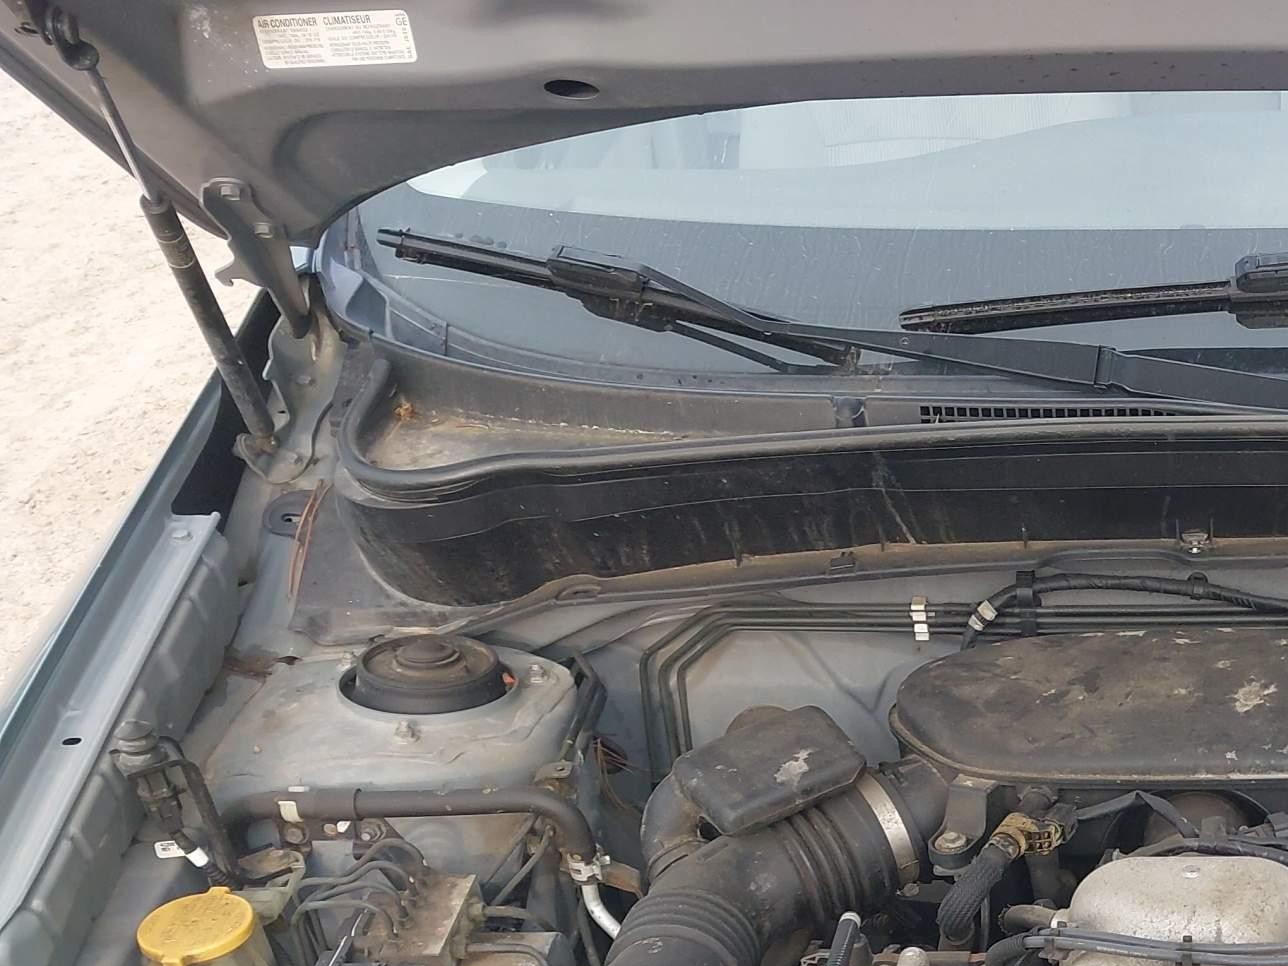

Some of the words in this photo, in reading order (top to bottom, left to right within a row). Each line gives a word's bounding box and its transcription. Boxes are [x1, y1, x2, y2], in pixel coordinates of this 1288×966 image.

[258, 18, 270, 28] AIR
[270, 17, 318, 27] CONDITIONER
[323, 14, 371, 25] CLIMATISEUR
